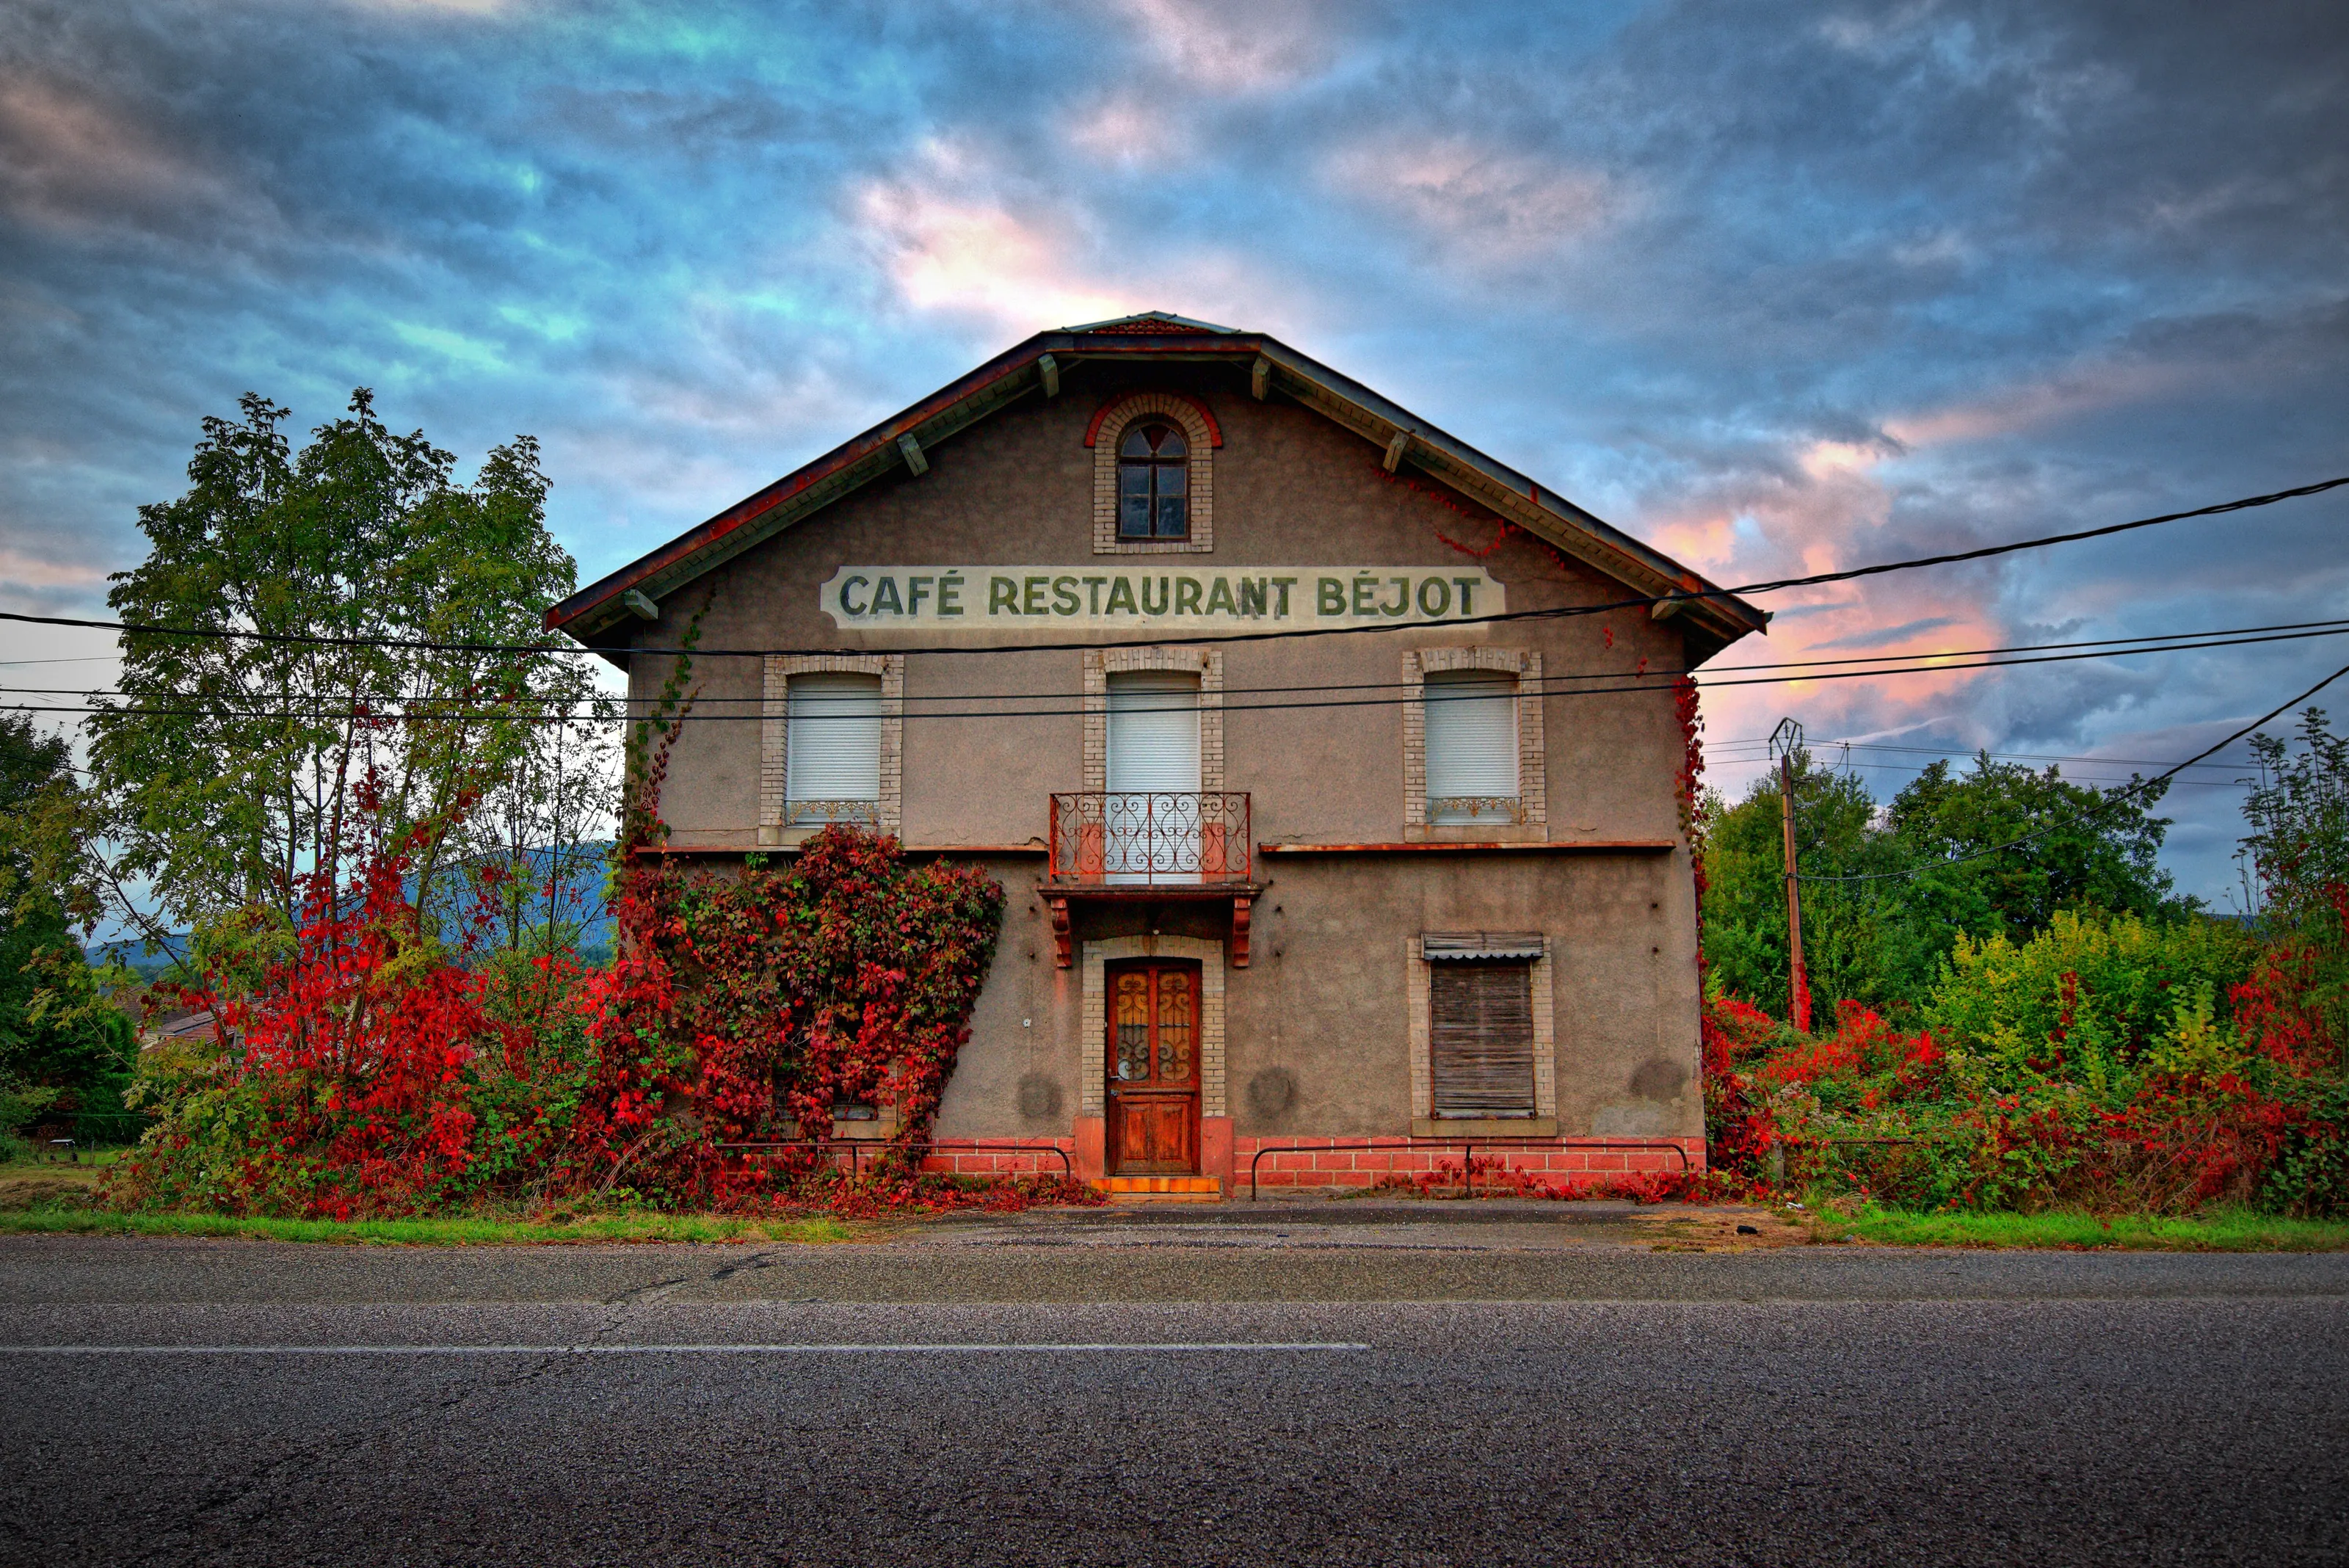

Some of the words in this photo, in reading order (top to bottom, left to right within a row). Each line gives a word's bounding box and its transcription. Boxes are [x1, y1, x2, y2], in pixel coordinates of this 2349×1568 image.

[839, 570, 965, 616] CAFÉ
[989, 576, 1298, 617] RESTAURANT
[1317, 570, 1481, 617] BÉJOT
